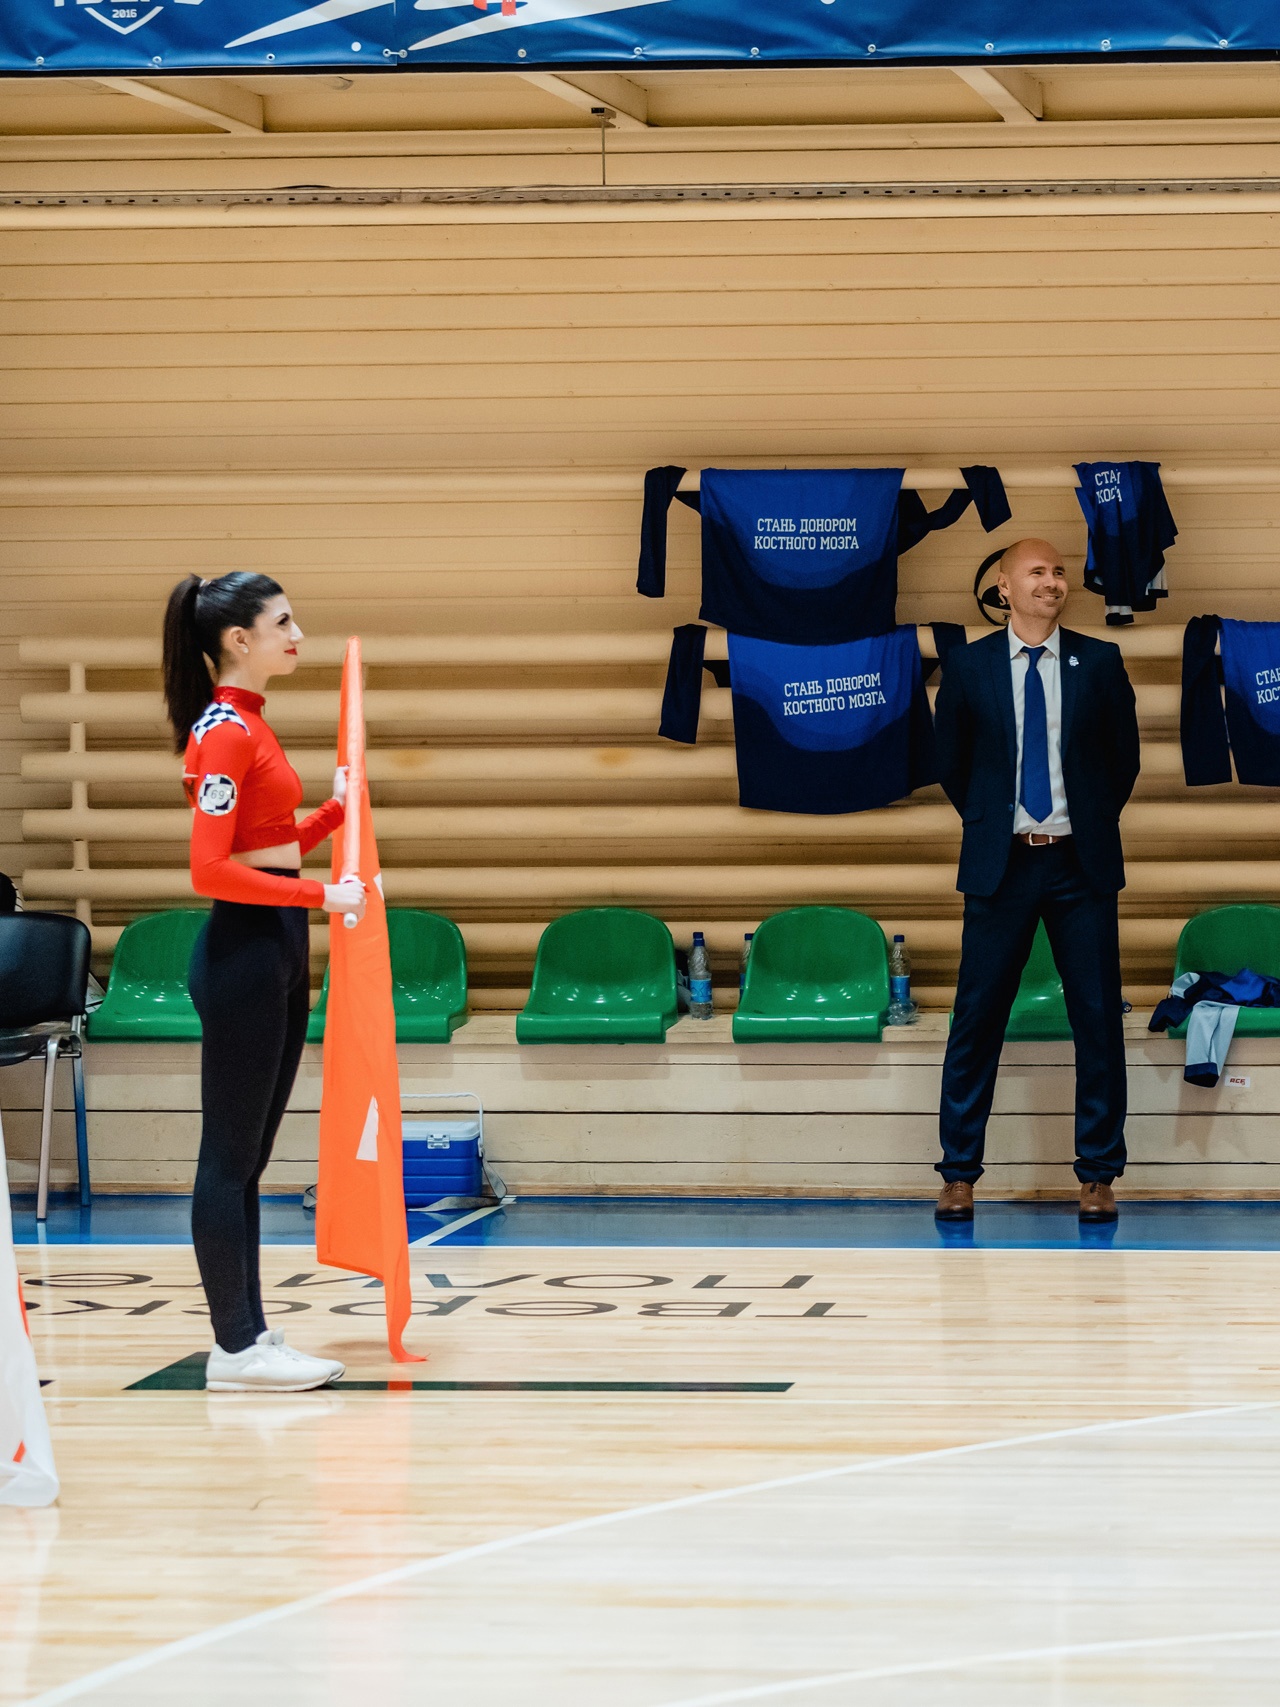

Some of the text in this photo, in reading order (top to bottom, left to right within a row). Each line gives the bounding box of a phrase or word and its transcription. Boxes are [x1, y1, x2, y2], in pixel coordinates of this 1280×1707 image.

[112, 9, 137, 18] 2016
[757, 518, 857, 534] СТАНЬ ДОНОРОМ
[754, 536, 859, 550] КОСТНОГО МОЗГА
[783, 672, 882, 697] СТАНЬ ДОНОРОМ
[783, 690, 887, 717] КОСТНОГО МОЗГА
[211, 790, 225, 800] 69
